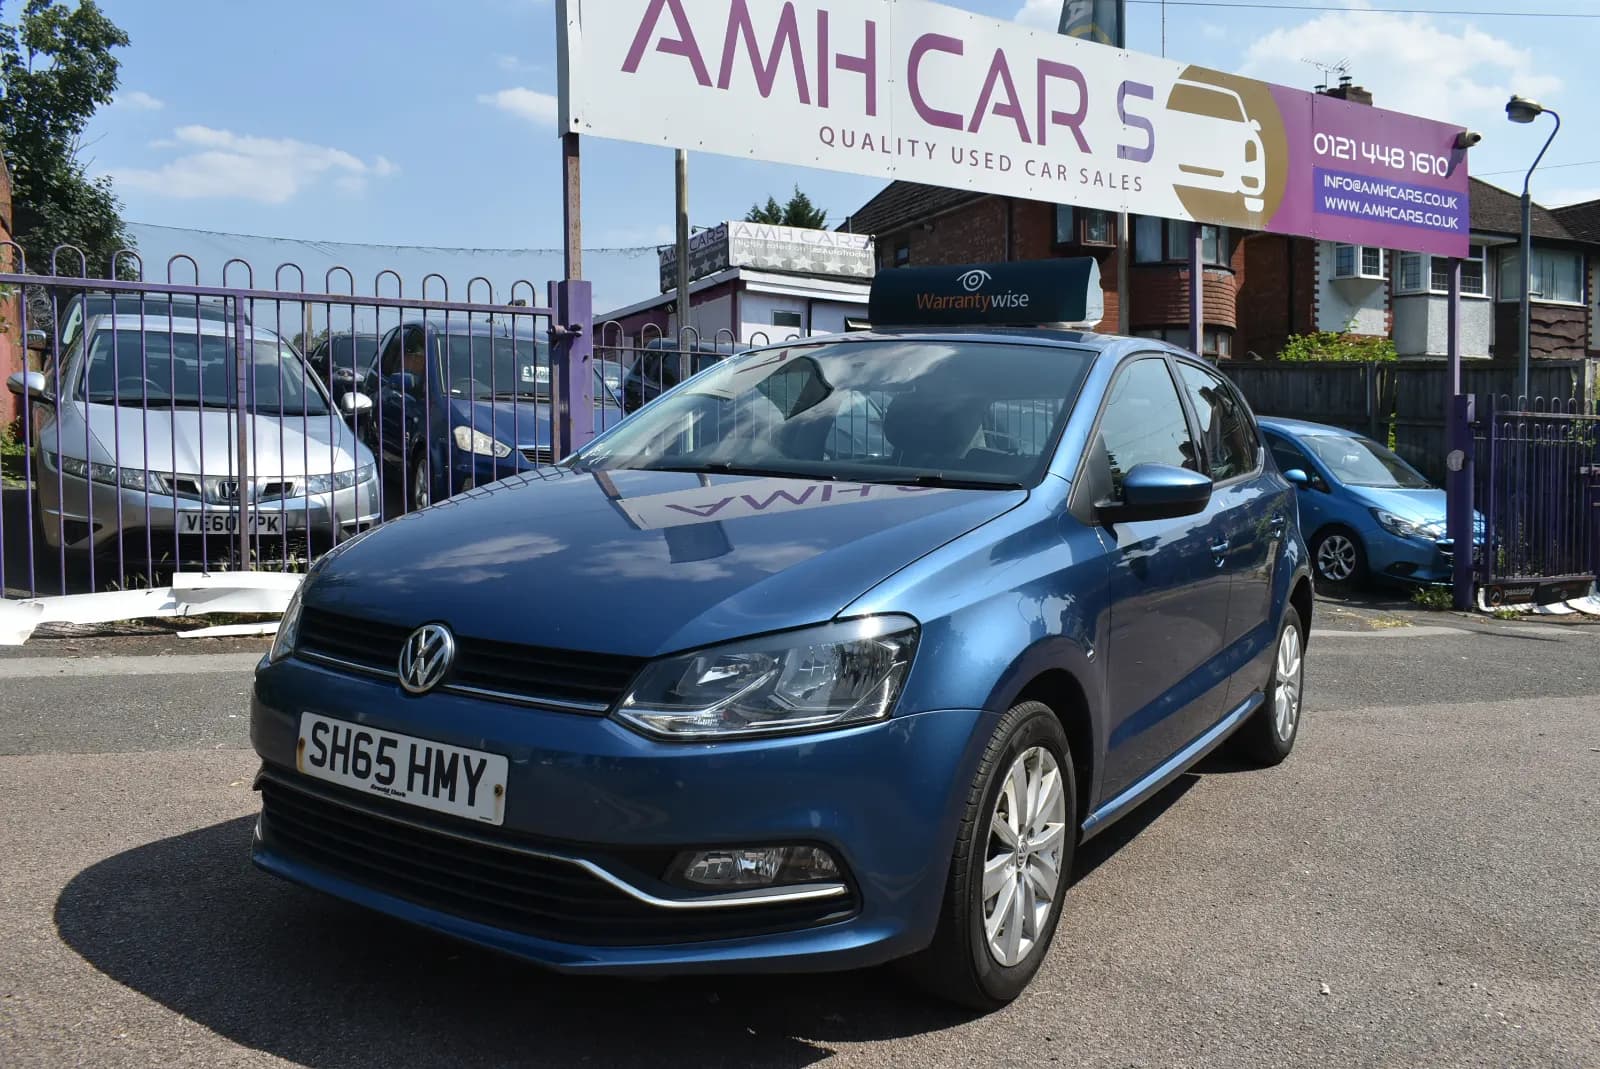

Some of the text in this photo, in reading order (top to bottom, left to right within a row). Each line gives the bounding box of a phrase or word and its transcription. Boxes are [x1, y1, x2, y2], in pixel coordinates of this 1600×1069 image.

[620, 0, 877, 117] AMH
[819, 125, 1143, 193] QUALITY USED CAR SALES
[1313, 132, 1449, 177] 0121 448 1610
[1324, 174, 1458, 210] INFO@AMHCARS.CO.UK
[1324, 195, 1459, 230] WWW.AMHCARS.CO.UK
[689, 226, 725, 252] CARS
[734, 222, 867, 250] AMH CARS
[916, 290, 1030, 312] Warrantywise
[186, 514, 237, 532] VE60
[309, 720, 488, 808] SH65 HMY
